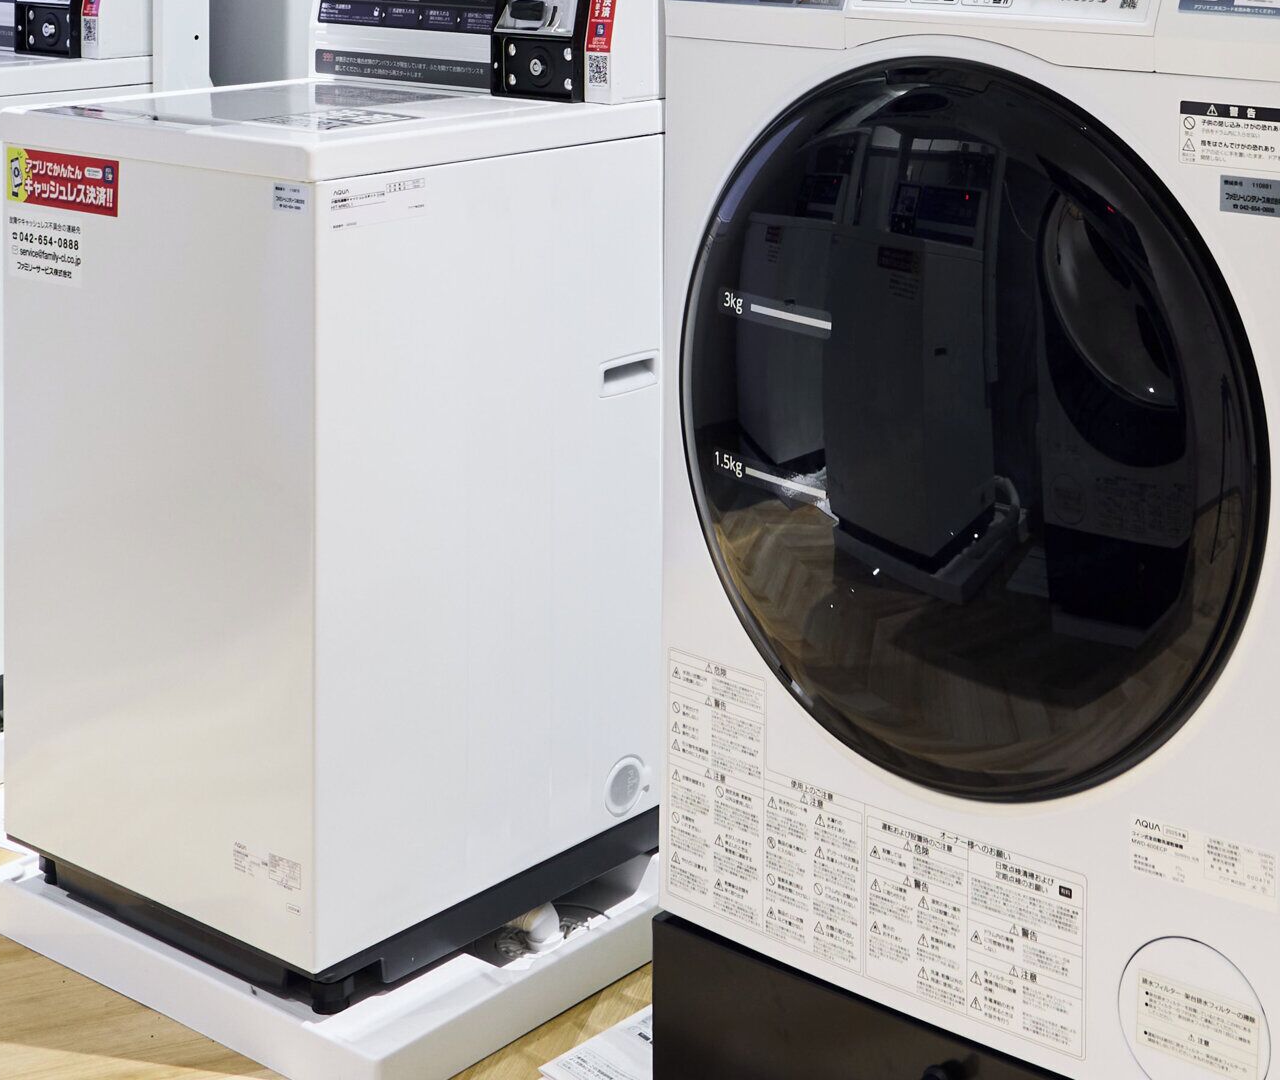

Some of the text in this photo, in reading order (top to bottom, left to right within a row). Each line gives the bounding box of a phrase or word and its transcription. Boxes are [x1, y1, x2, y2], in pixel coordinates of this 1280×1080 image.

[25, 160, 82, 180] アプリでかんたん
[19, 232, 79, 251] 042-654-0888
[724, 292, 743, 314] 3kg
[714, 450, 742, 478] 1.5kg
[791, 780, 834, 801] 使用上のご注意
[1135, 818, 1161, 832] AQUA
[940, 831, 1011, 861] オーナー様へのお願い
